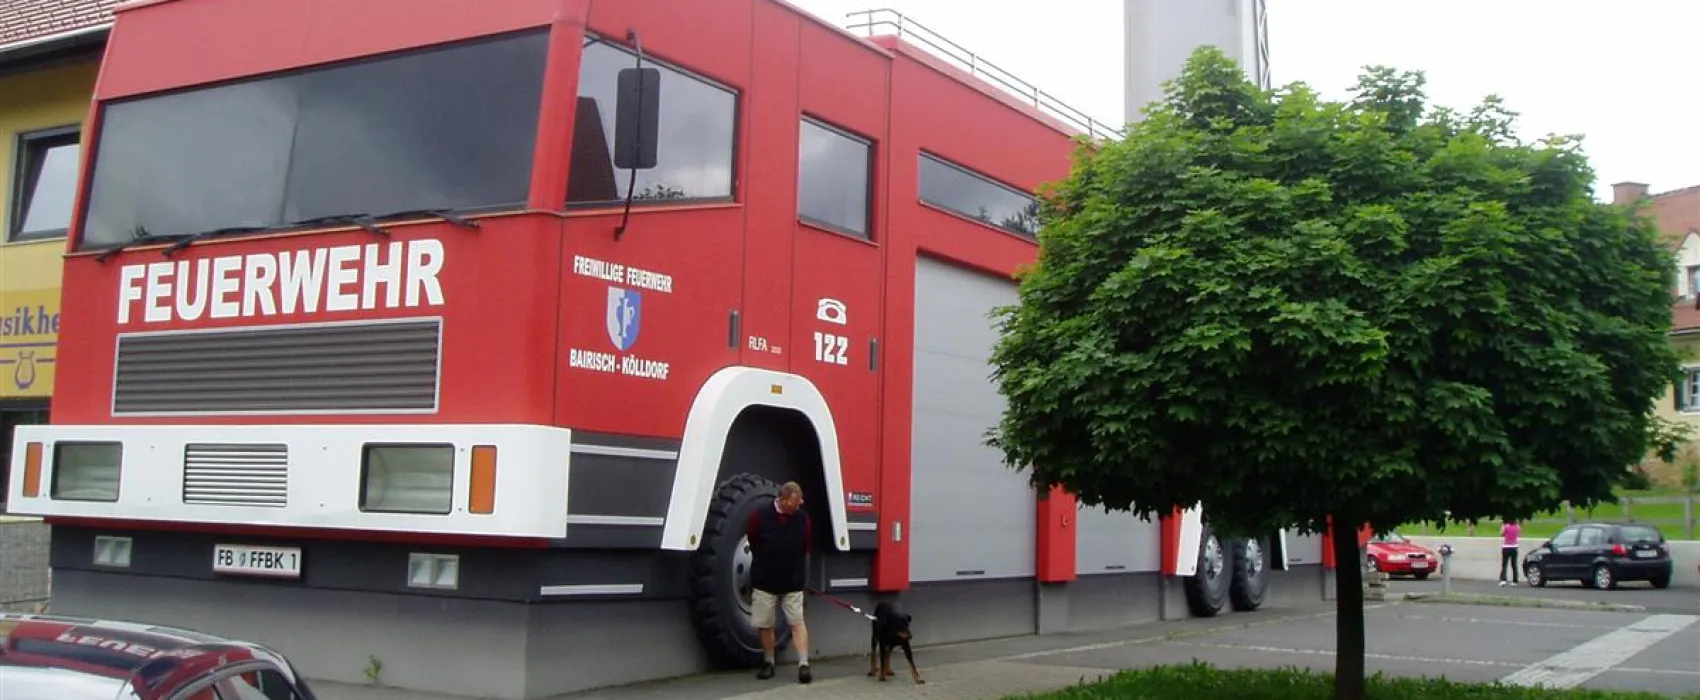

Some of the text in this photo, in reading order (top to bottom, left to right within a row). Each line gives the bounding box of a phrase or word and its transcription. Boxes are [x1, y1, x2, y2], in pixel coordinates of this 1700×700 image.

[117, 238, 445, 324] FEUERWEHR
[573, 254, 673, 293] FREIWILLIGE FEUERWEHR
[0, 305, 60, 336] sikhe
[569, 348, 616, 373] BAIRISCH
[621, 353, 669, 380] KÖLLDORF
[813, 331, 848, 365] 122
[218, 549, 297, 570] FB FFBK 1
